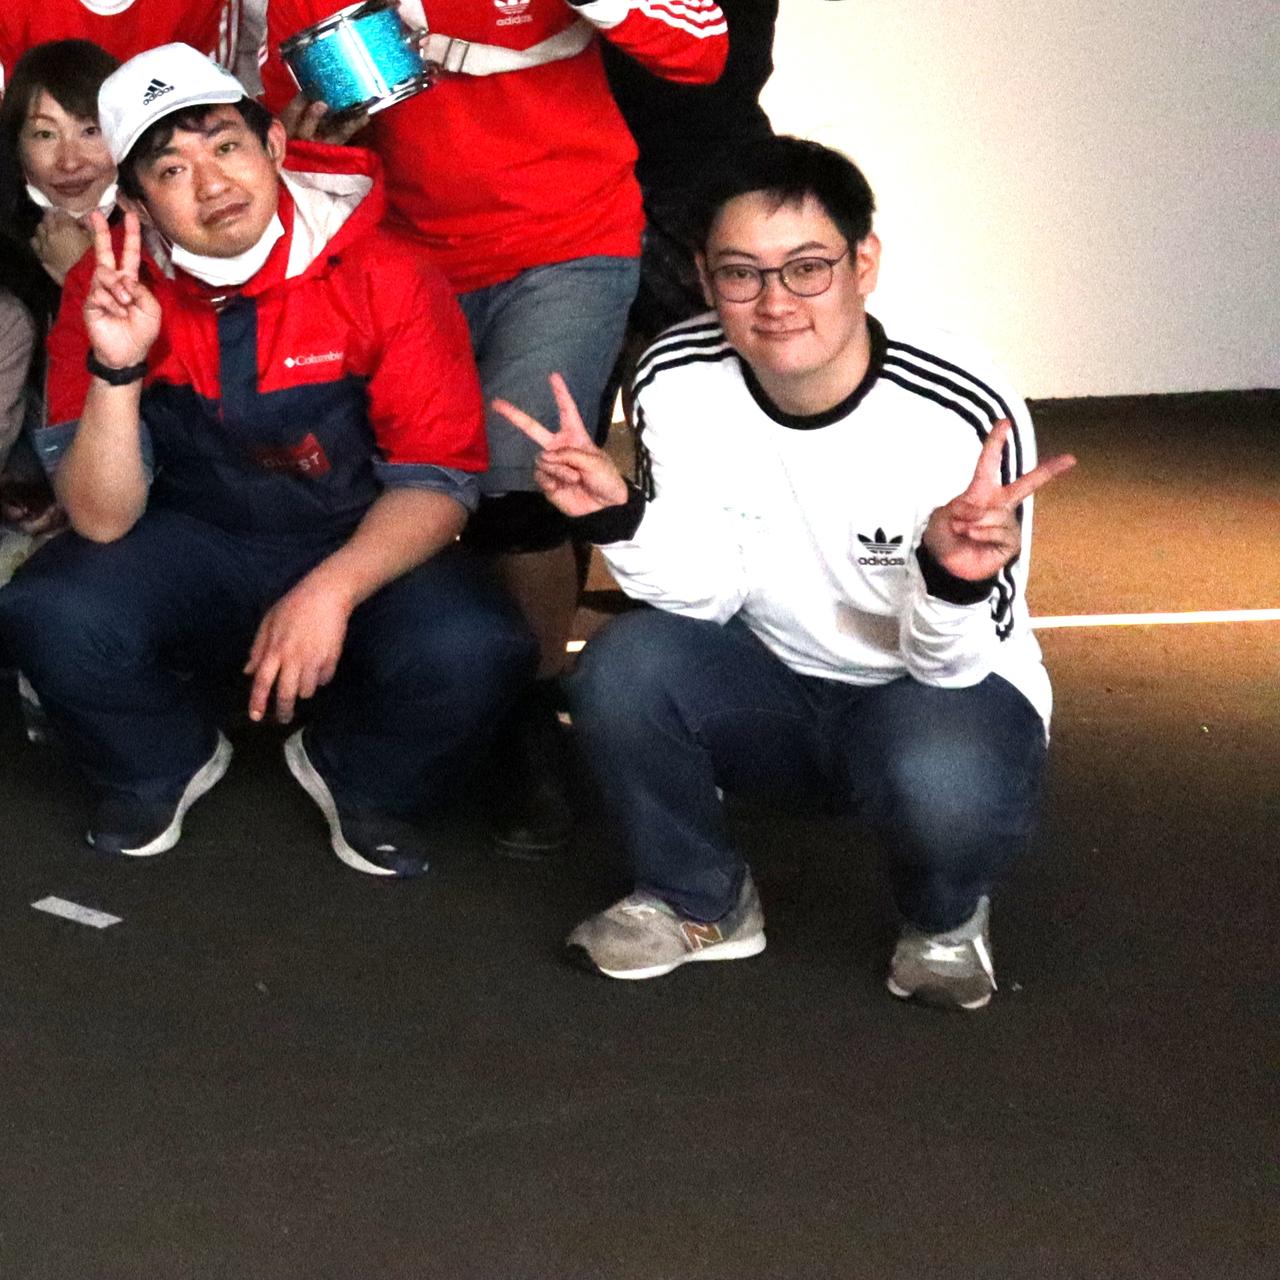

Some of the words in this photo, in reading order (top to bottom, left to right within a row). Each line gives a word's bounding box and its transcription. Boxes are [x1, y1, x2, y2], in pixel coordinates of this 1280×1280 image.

[495, 13, 534, 27] adidas
[142, 84, 175, 106] adidas
[857, 556, 906, 567] adidas
